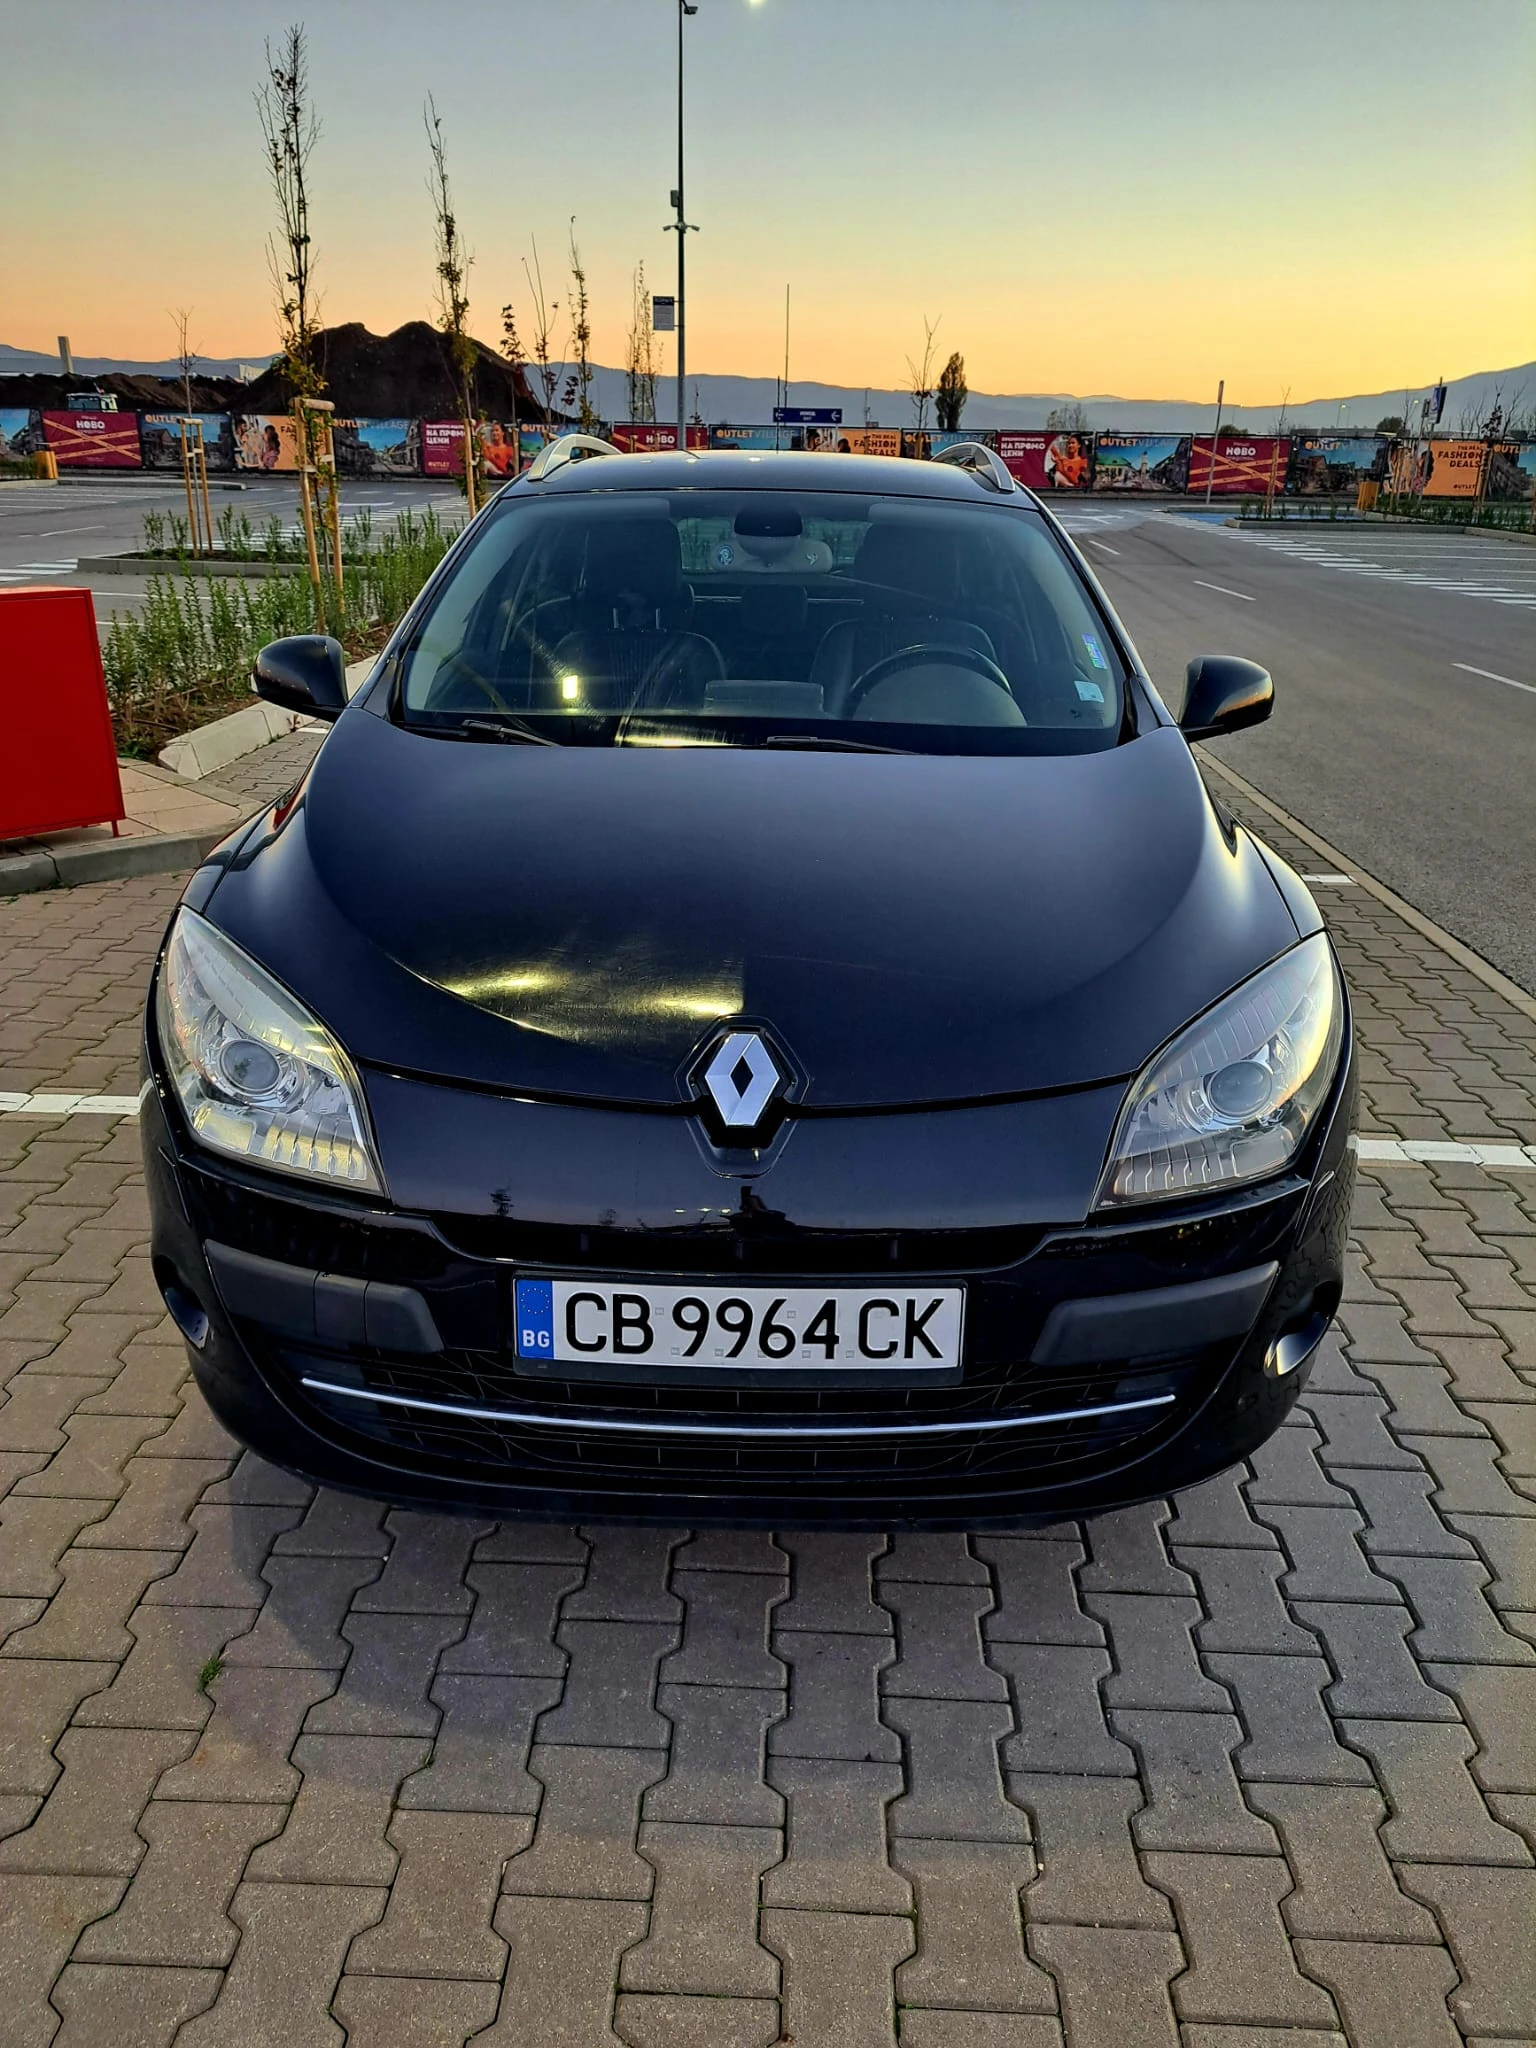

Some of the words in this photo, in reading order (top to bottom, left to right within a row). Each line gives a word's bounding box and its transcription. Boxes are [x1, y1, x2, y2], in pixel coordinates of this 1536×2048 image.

[440, 429, 465, 438] ПРОМ
[716, 429, 753, 439] OUTLET
[646, 434, 675, 444] НВО
[1100, 438, 1137, 447] OUTLET
[1001, 442, 1014, 450] НА
[1226, 446, 1256, 456] НОВО
[564, 1291, 655, 1355] CB
[672, 1296, 840, 1360] 9964
[857, 1297, 946, 1360] CK
[522, 1328, 551, 1349] BG
